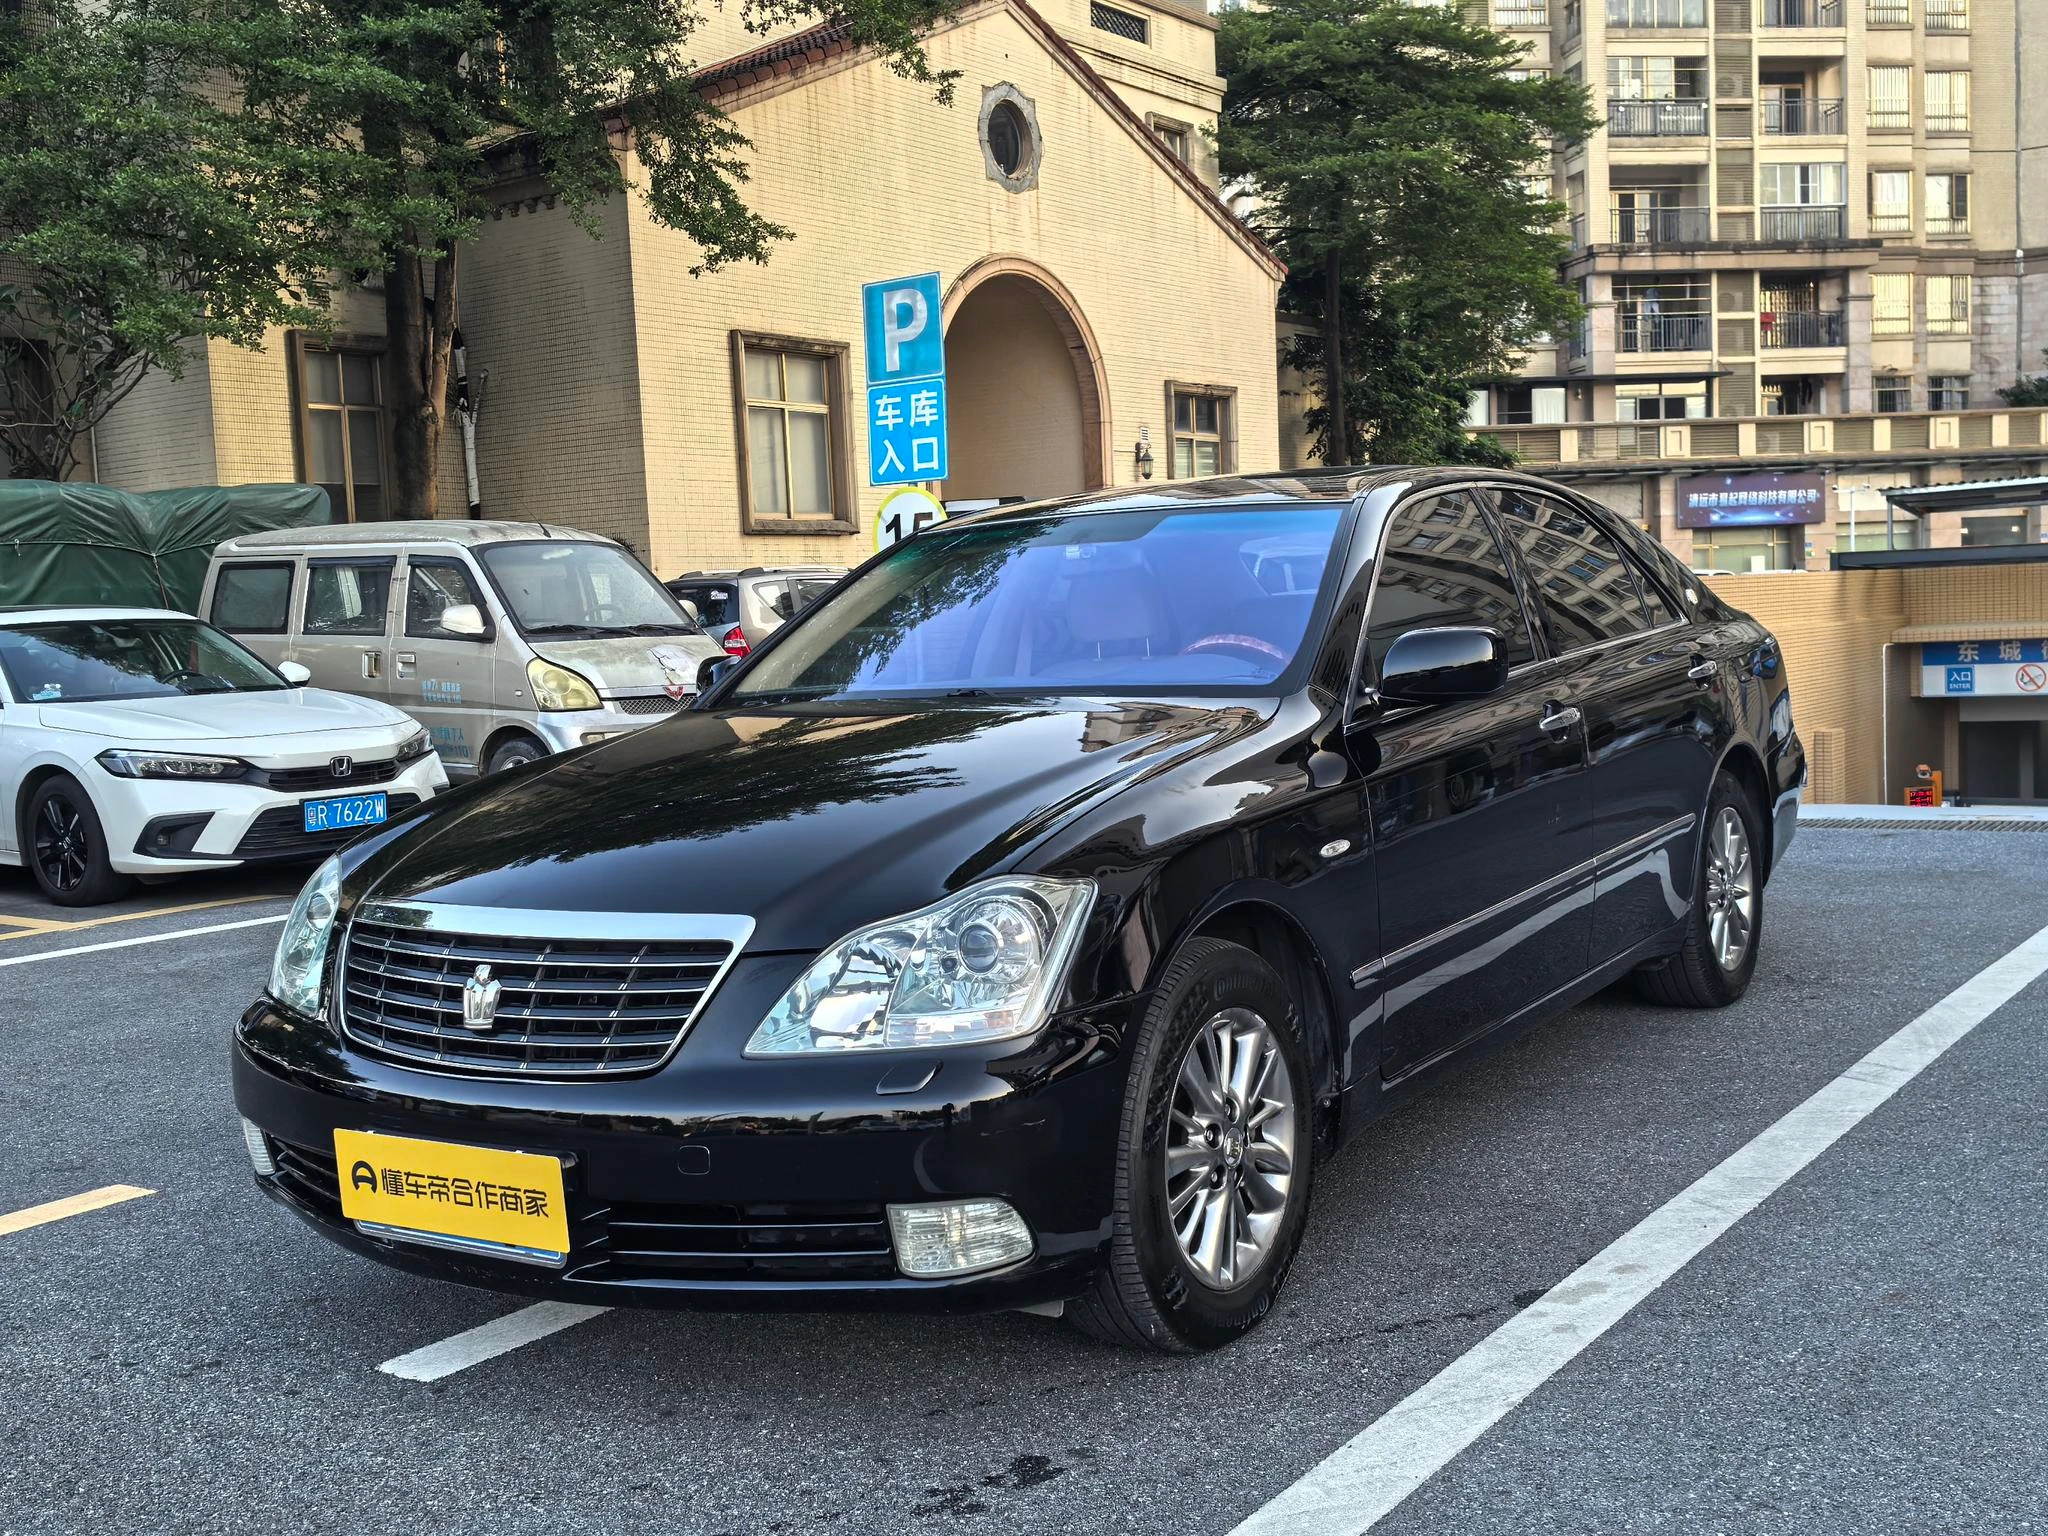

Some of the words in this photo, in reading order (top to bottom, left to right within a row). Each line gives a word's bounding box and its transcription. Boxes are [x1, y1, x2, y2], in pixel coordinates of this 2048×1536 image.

[883, 288, 928, 373] P
[875, 389, 939, 431] 车库
[877, 436, 940, 476] 入口
[1950, 671, 1971, 681] 入口
[380, 1167, 549, 1218] 懂车帝合作商家
